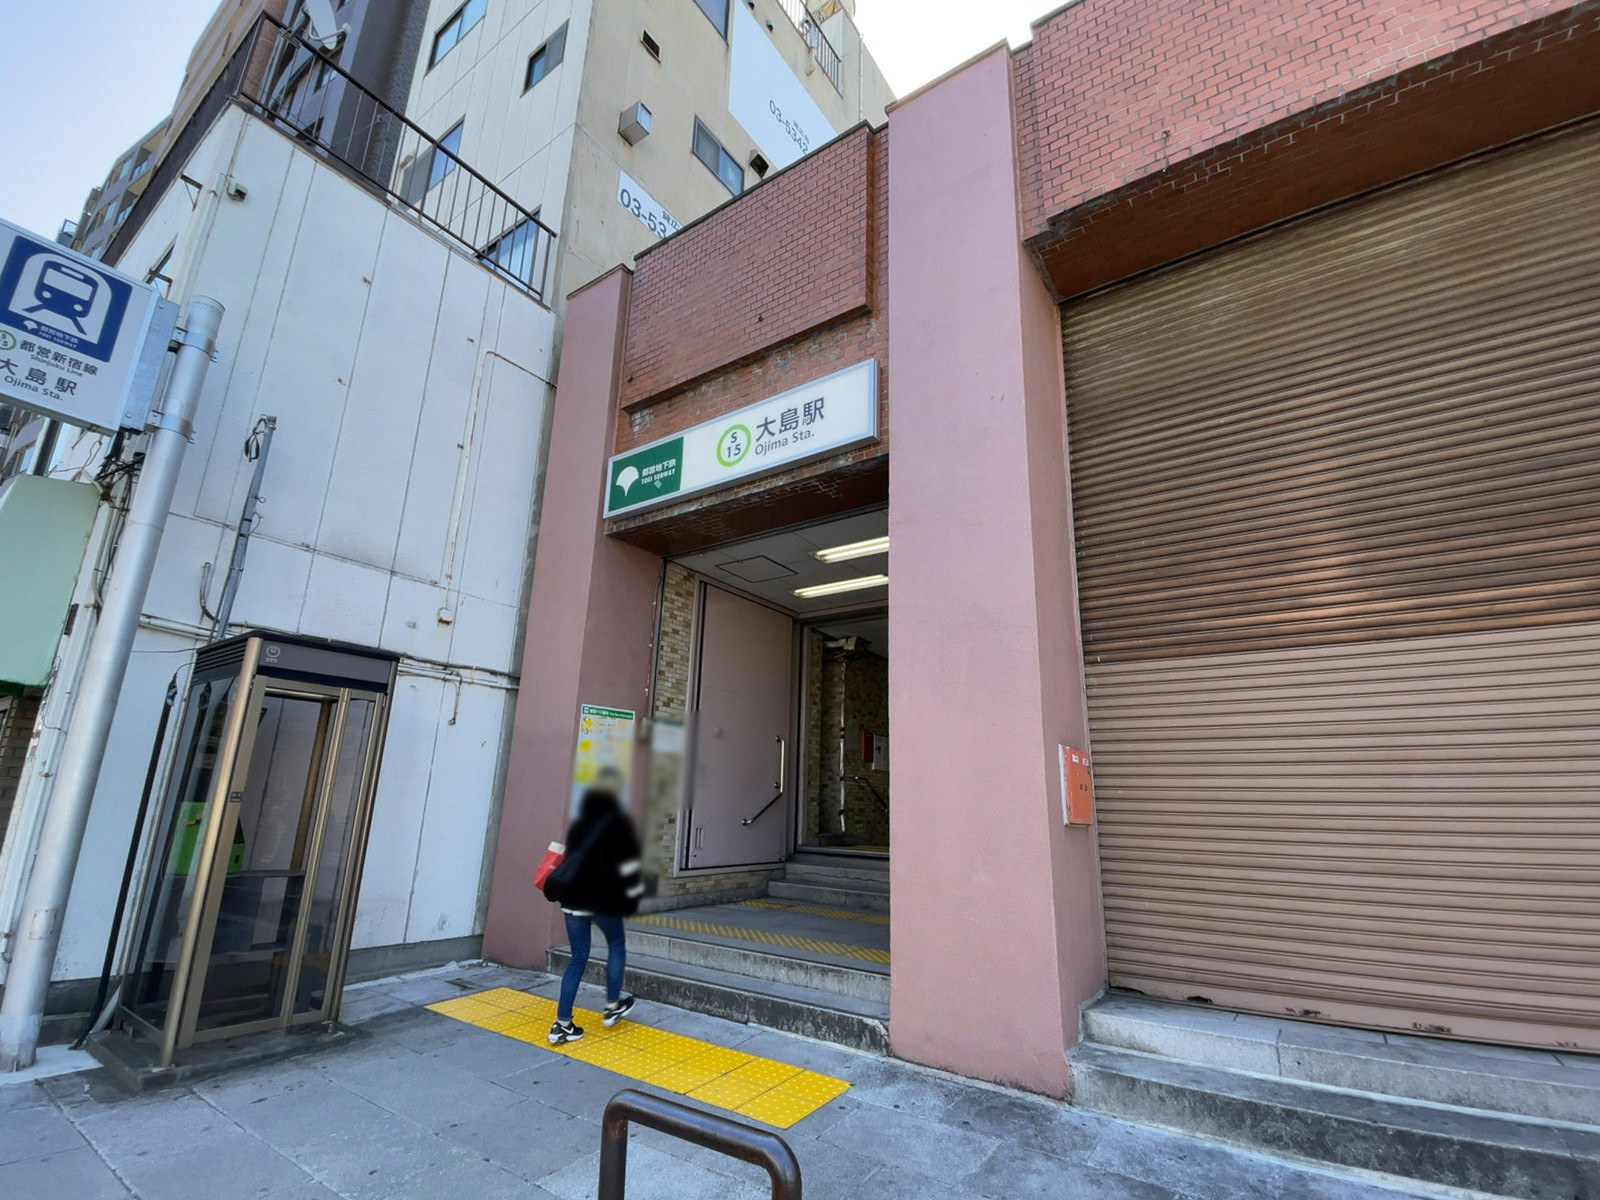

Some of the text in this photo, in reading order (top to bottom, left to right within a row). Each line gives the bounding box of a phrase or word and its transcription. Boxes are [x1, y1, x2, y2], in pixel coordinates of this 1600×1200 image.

[20, 339, 98, 376] 都営新宿線
[30, 353, 84, 378] Shinjuku Line
[0, 358, 77, 396] 大島駅
[4, 375, 63, 401] Ojima Sta.
[755, 397, 825, 442] 大島駅
[730, 431, 739, 444] S
[754, 429, 815, 456] Ojima Sta.
[726, 443, 741, 459] 15
